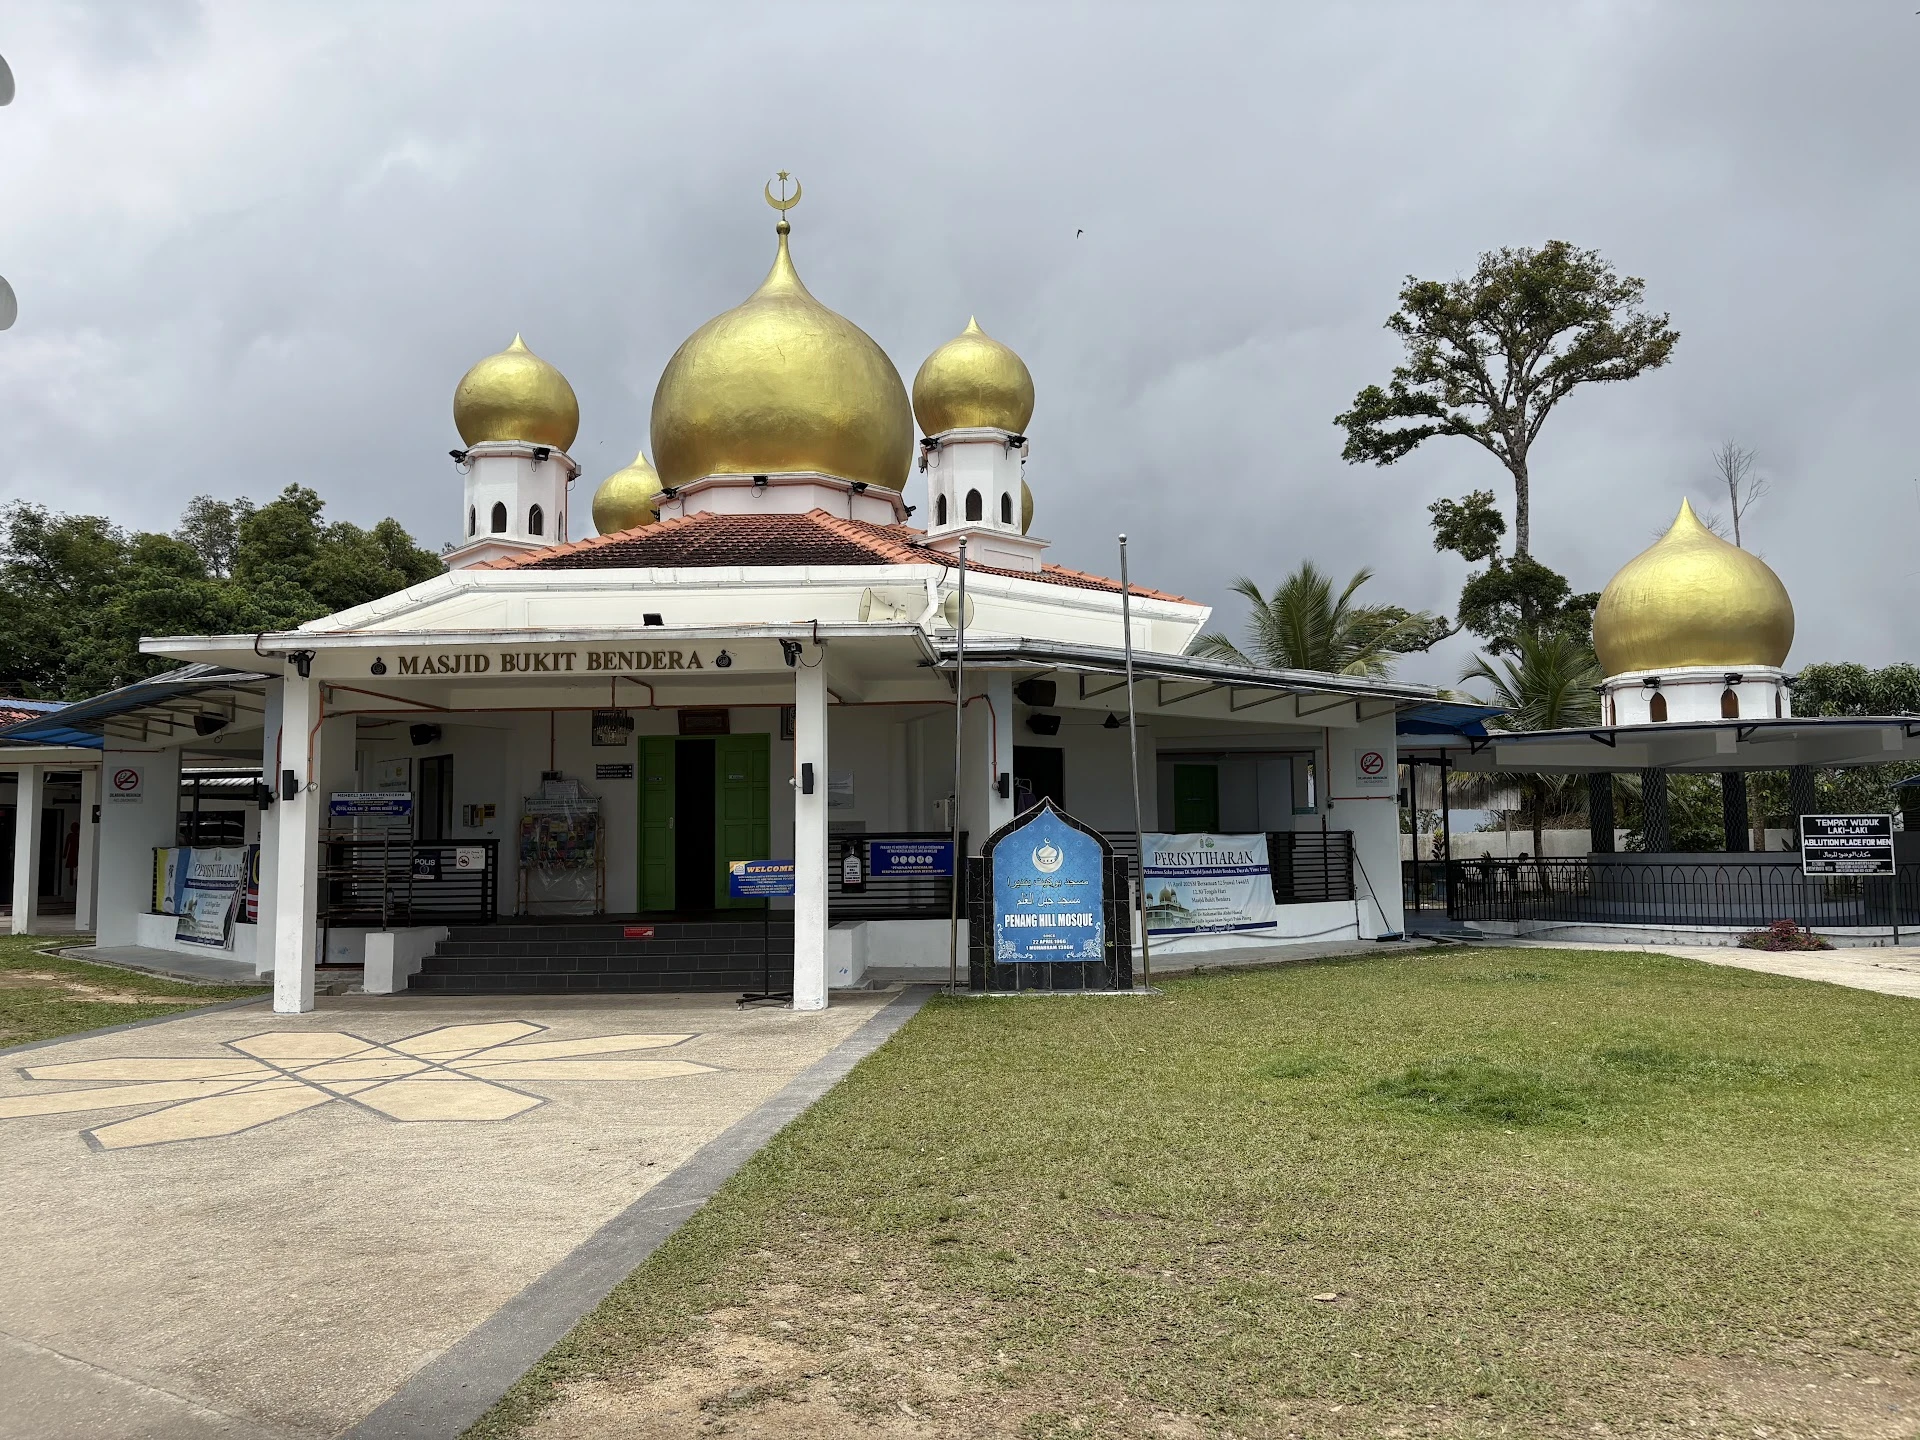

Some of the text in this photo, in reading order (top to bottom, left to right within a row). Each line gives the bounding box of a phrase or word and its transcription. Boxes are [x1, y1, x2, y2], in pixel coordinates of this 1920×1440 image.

[398, 650, 703, 675] MASJID BUKIT BENDERA
[1154, 851, 1254, 866] PERISYTIHARAN
[747, 865, 794, 873] WELCOME
[1064, 878, 1089, 887] مسجد
[1058, 896, 1080, 906] مسجد
[1005, 913, 1093, 928] PENANG HILL MOSQUE
